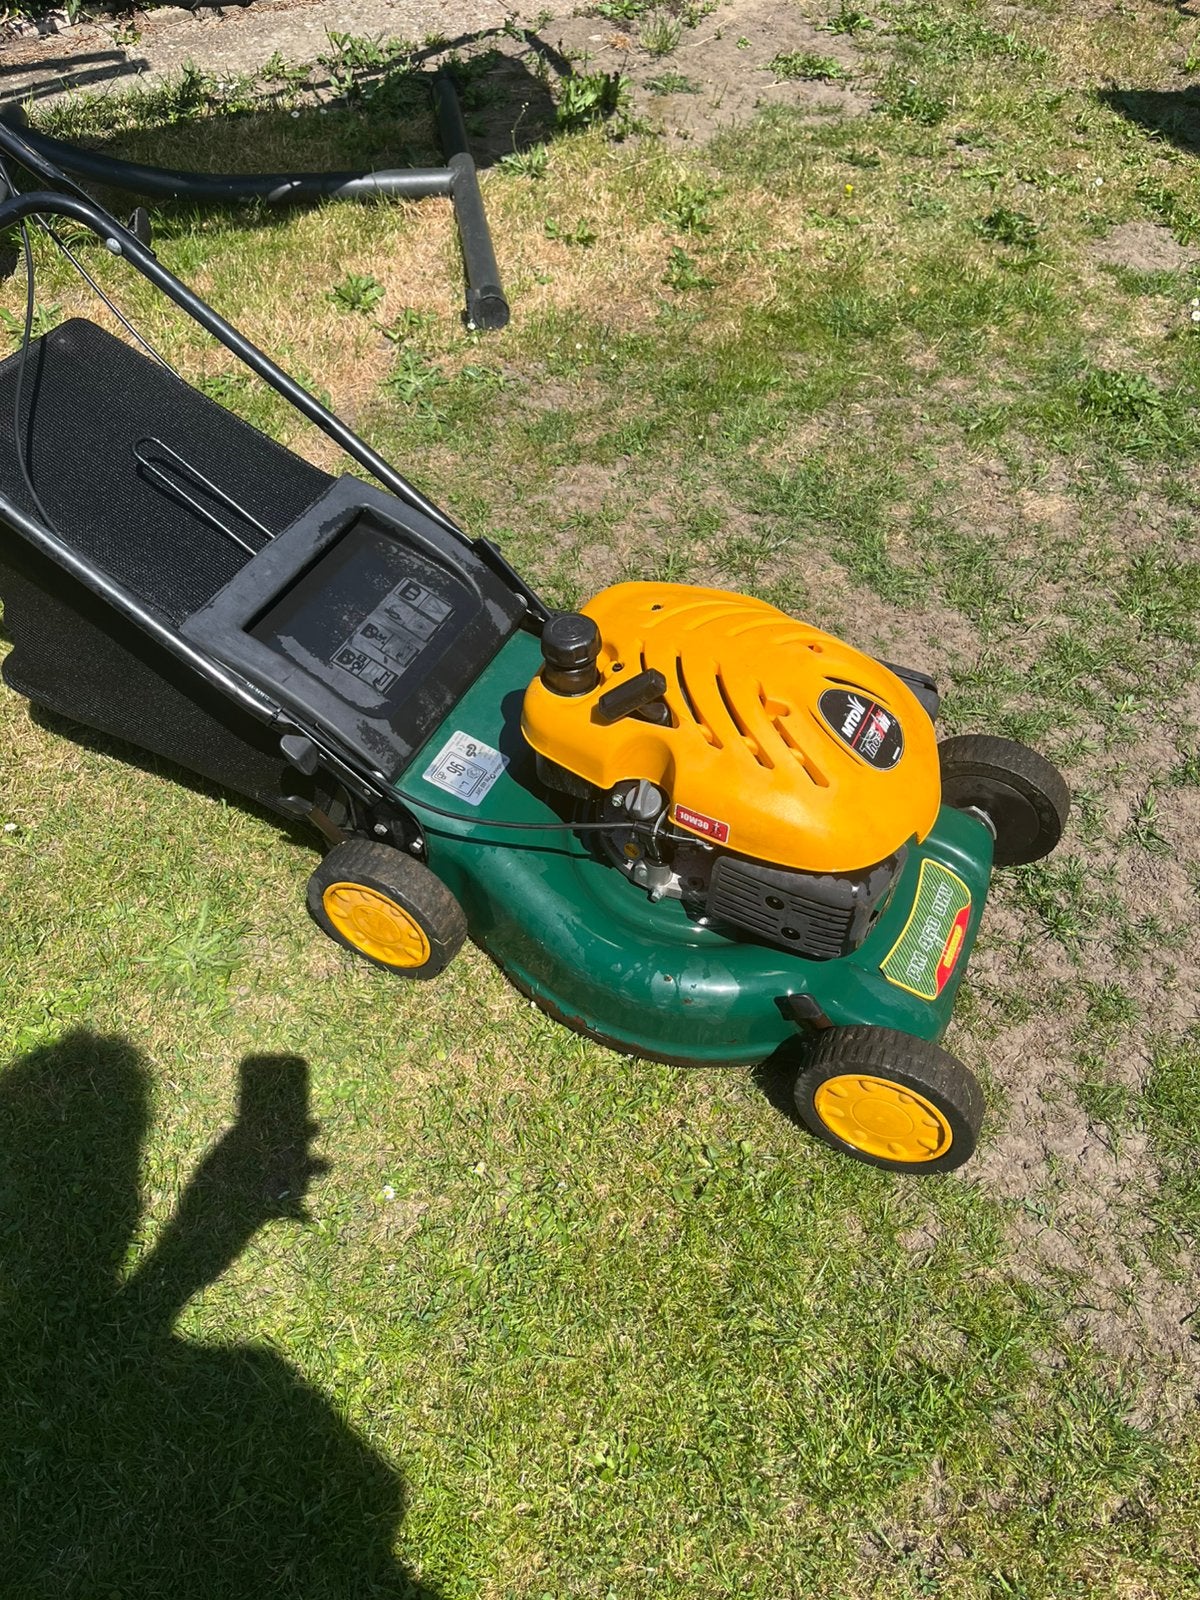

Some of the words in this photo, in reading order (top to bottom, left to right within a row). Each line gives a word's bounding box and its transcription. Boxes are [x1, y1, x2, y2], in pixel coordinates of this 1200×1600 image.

[841, 710, 863, 738] MTD
[446, 761, 466, 777] 96
[679, 811, 709, 831] 10W30
